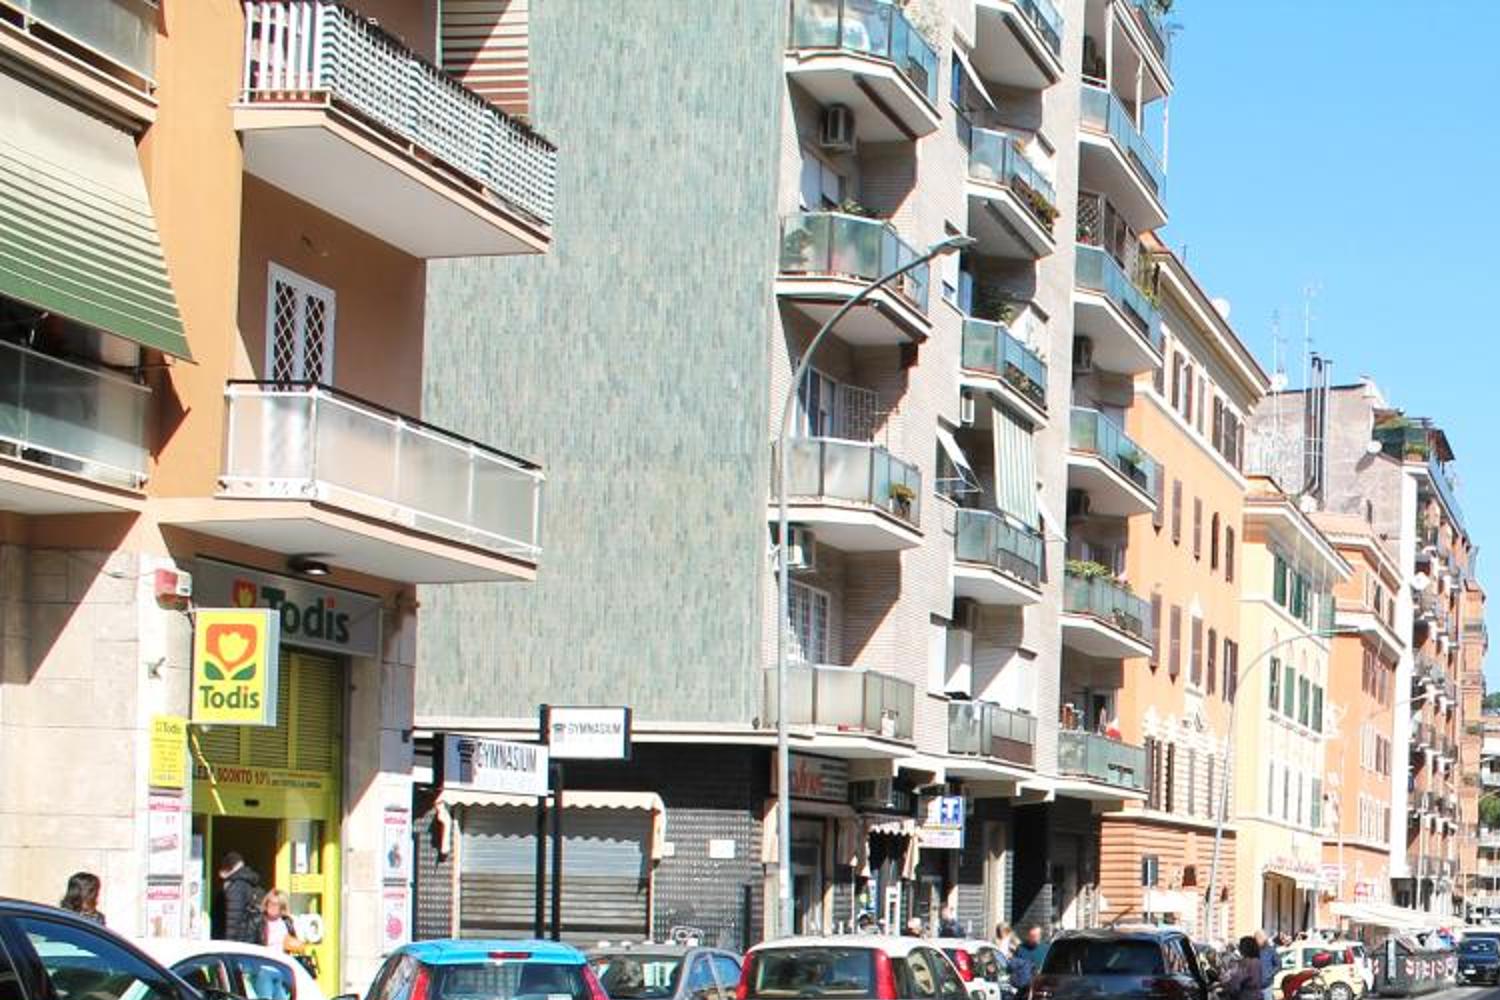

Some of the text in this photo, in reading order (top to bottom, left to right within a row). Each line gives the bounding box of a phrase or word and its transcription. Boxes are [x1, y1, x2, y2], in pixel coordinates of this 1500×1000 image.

[199, 685, 260, 710] Todis
[567, 722, 621, 735] GYMNASIUM
[475, 741, 537, 773] GYMNASIUM
